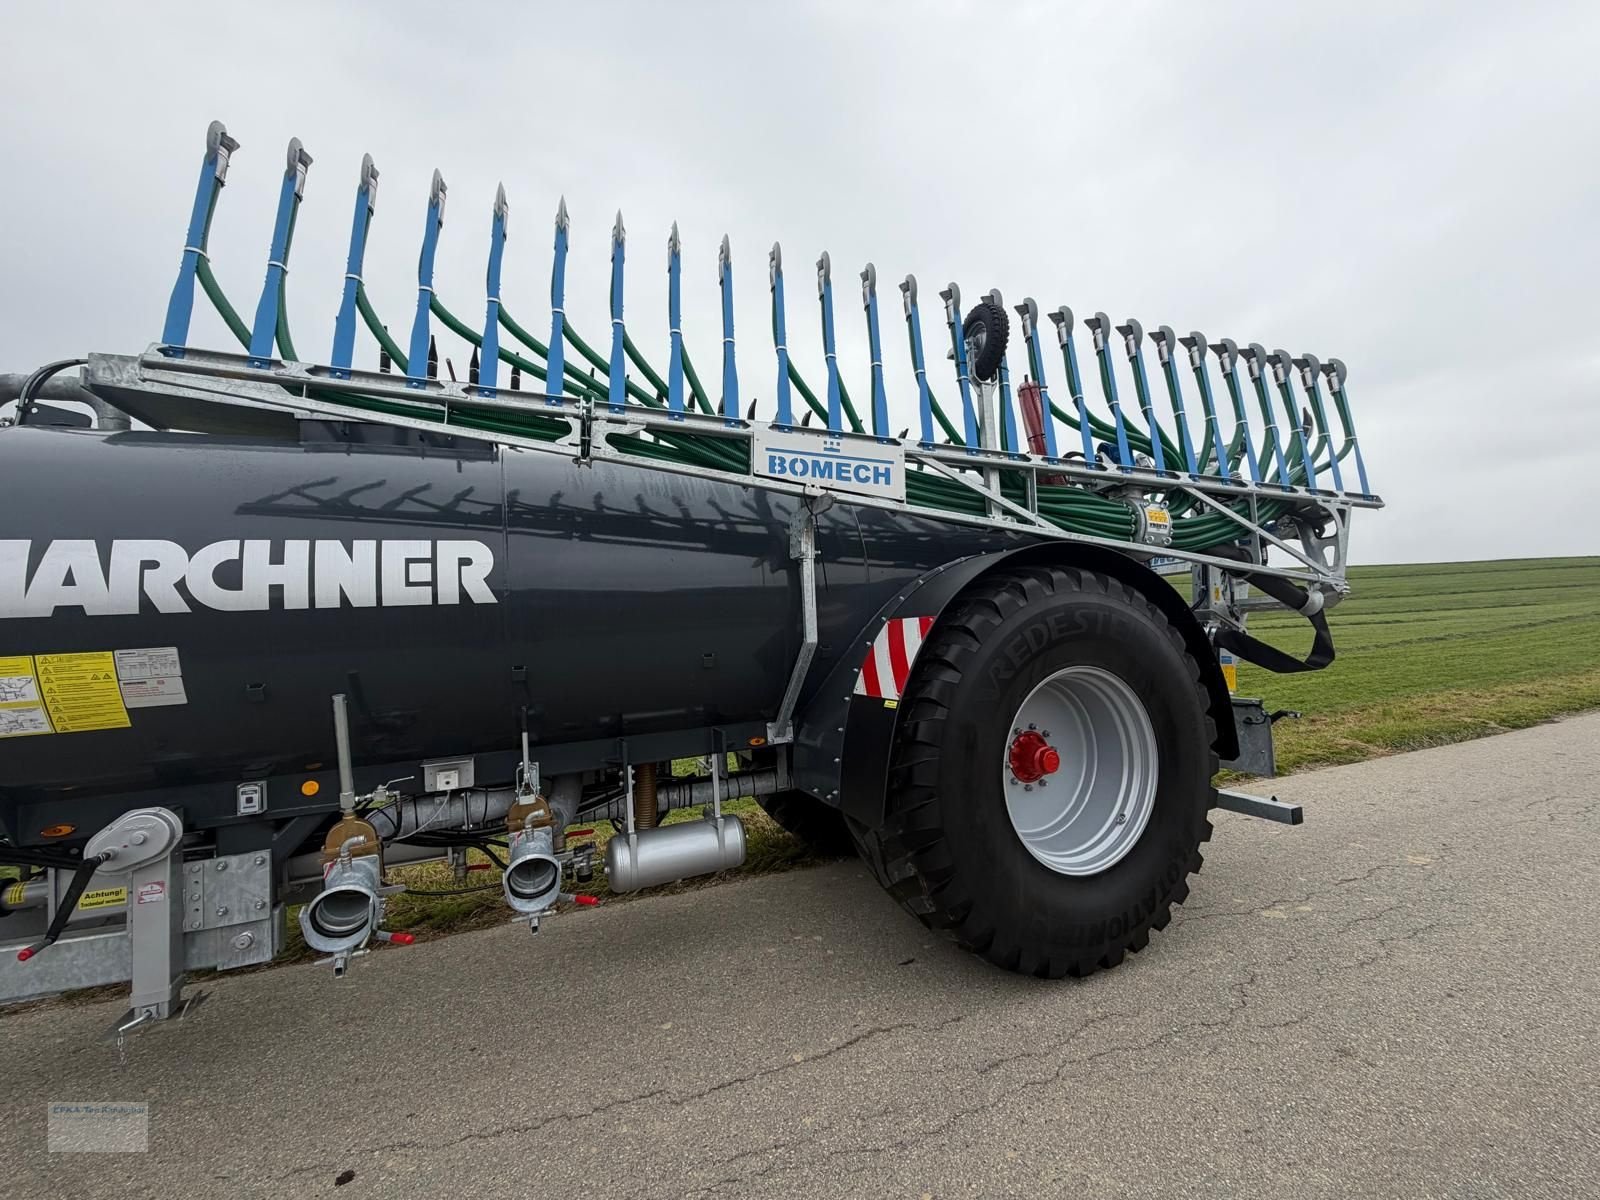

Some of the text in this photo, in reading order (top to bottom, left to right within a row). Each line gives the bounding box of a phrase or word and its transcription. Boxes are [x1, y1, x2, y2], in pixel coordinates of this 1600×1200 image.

[768, 455, 891, 485] BOMECH
[0, 539, 498, 618] ARCHNER
[85, 889, 122, 899] Achtung!
